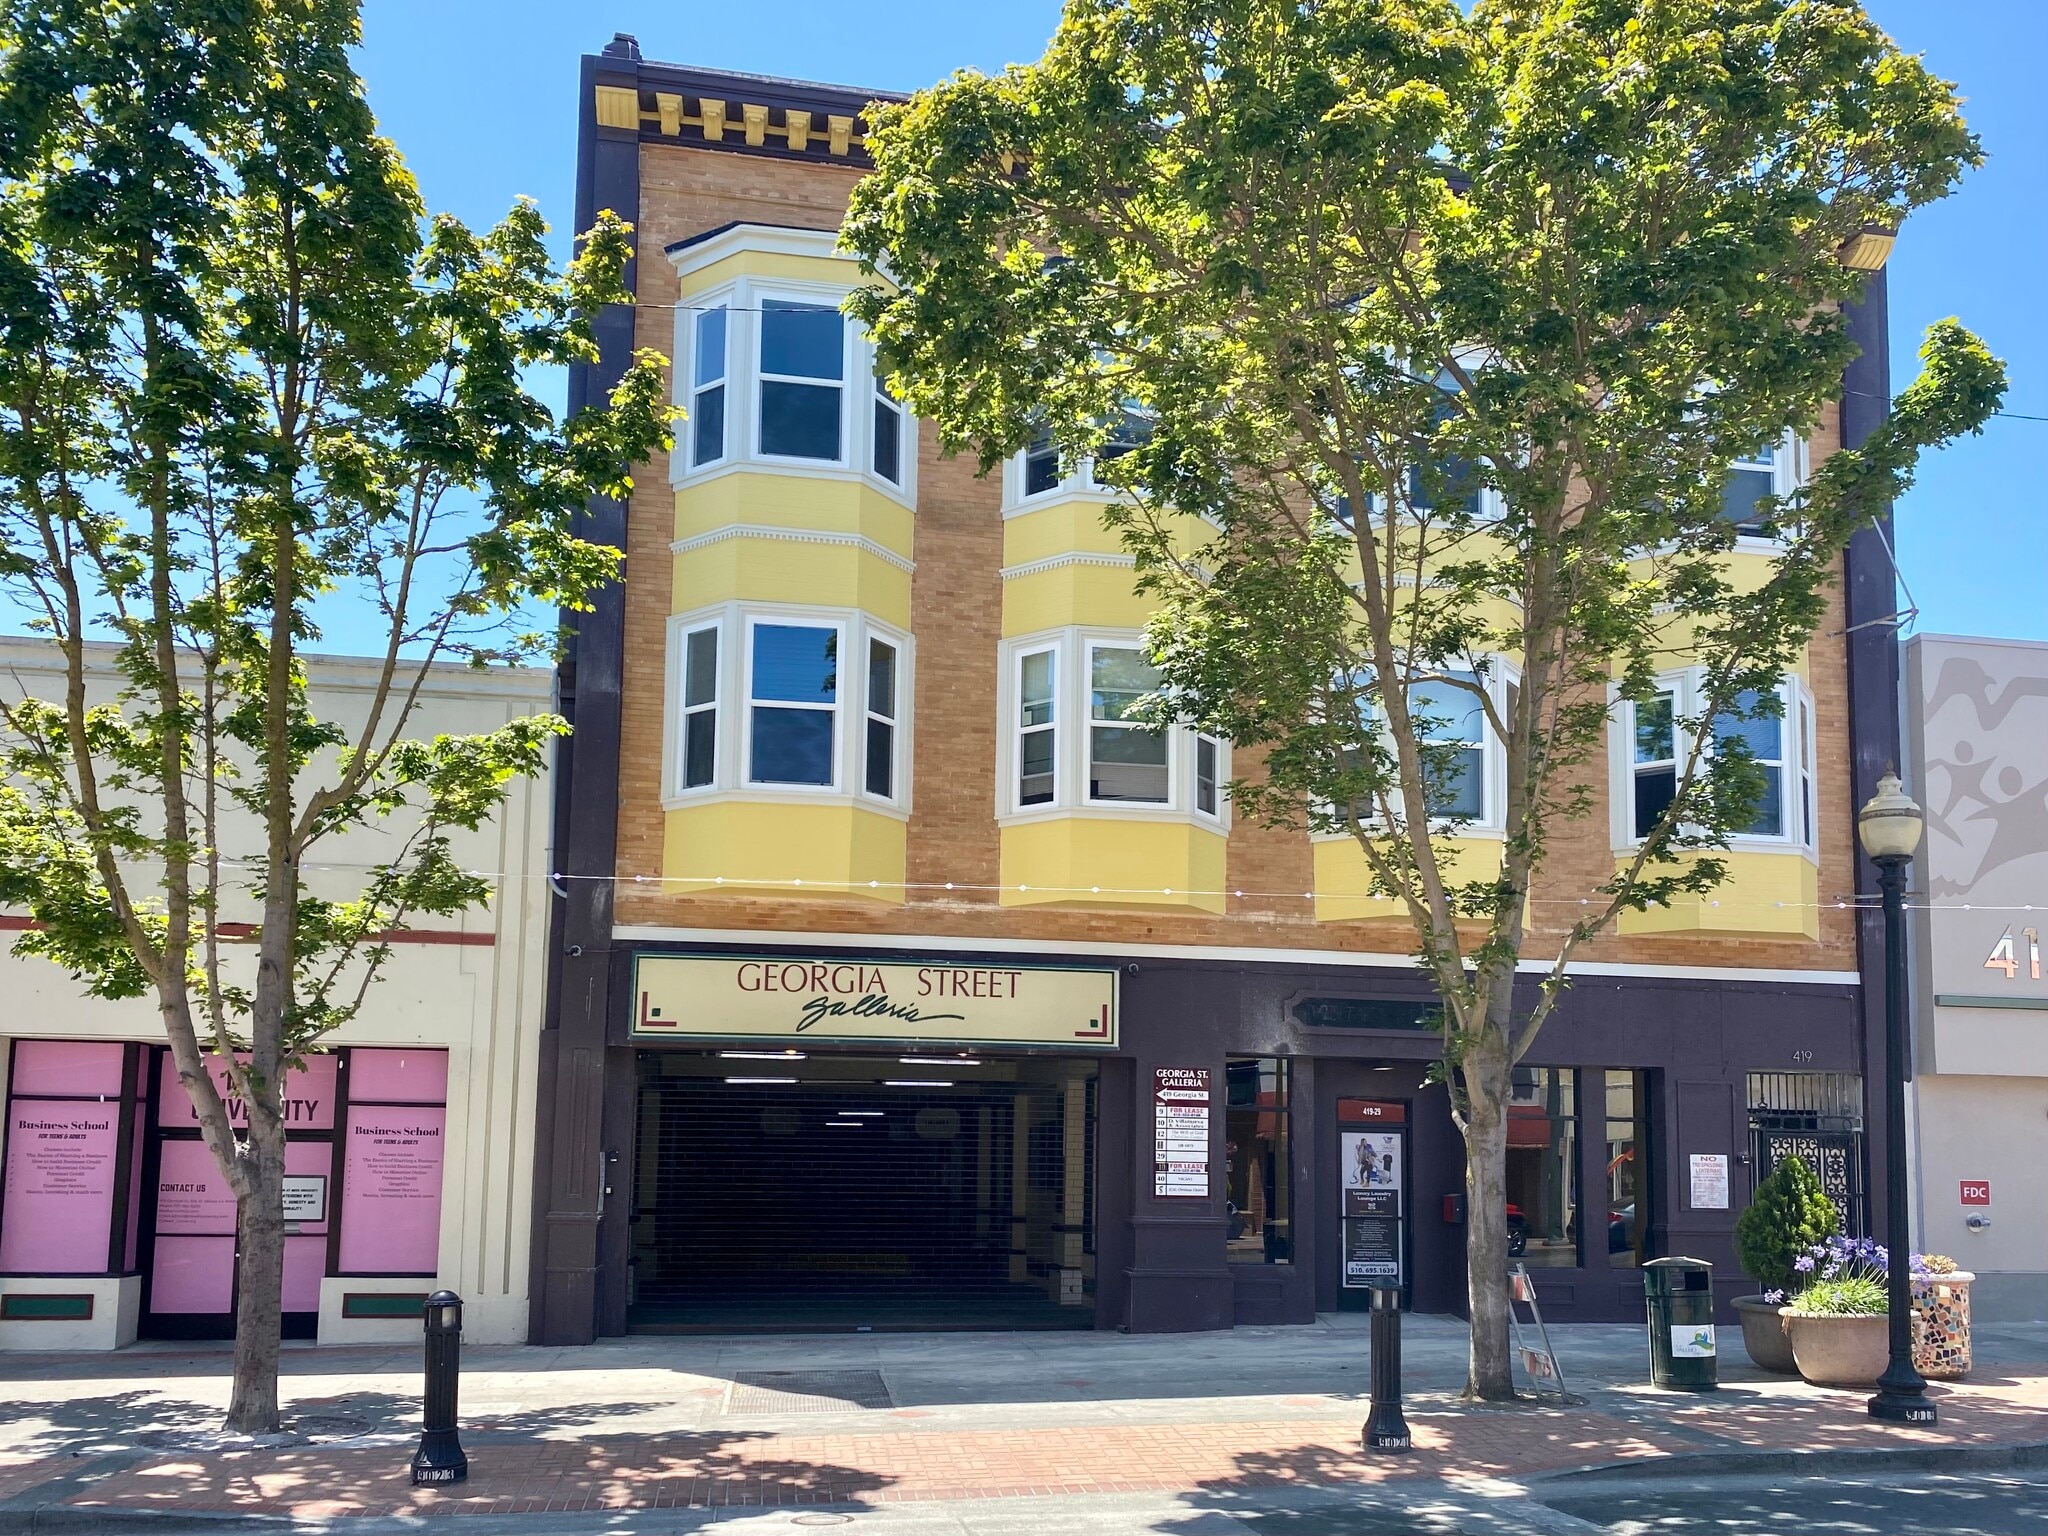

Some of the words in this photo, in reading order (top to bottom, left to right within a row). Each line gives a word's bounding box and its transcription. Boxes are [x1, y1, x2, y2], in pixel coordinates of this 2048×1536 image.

[738, 963, 886, 994] GEORGIA
[918, 968, 1022, 998] STREET
[1793, 1050, 1812, 1062] 419
[1156, 1069, 1196, 1078] GEORGIA
[1197, 1070, 1208, 1078] ST.
[1162, 1078, 1202, 1087] GALLERIA
[19, 1120, 68, 1129] Business
[71, 1120, 108, 1130] School
[355, 1126, 401, 1135] Business
[403, 1127, 439, 1136] School
[160, 1184, 194, 1192] CONTACT
[1964, 1186, 1986, 1198] FDC
